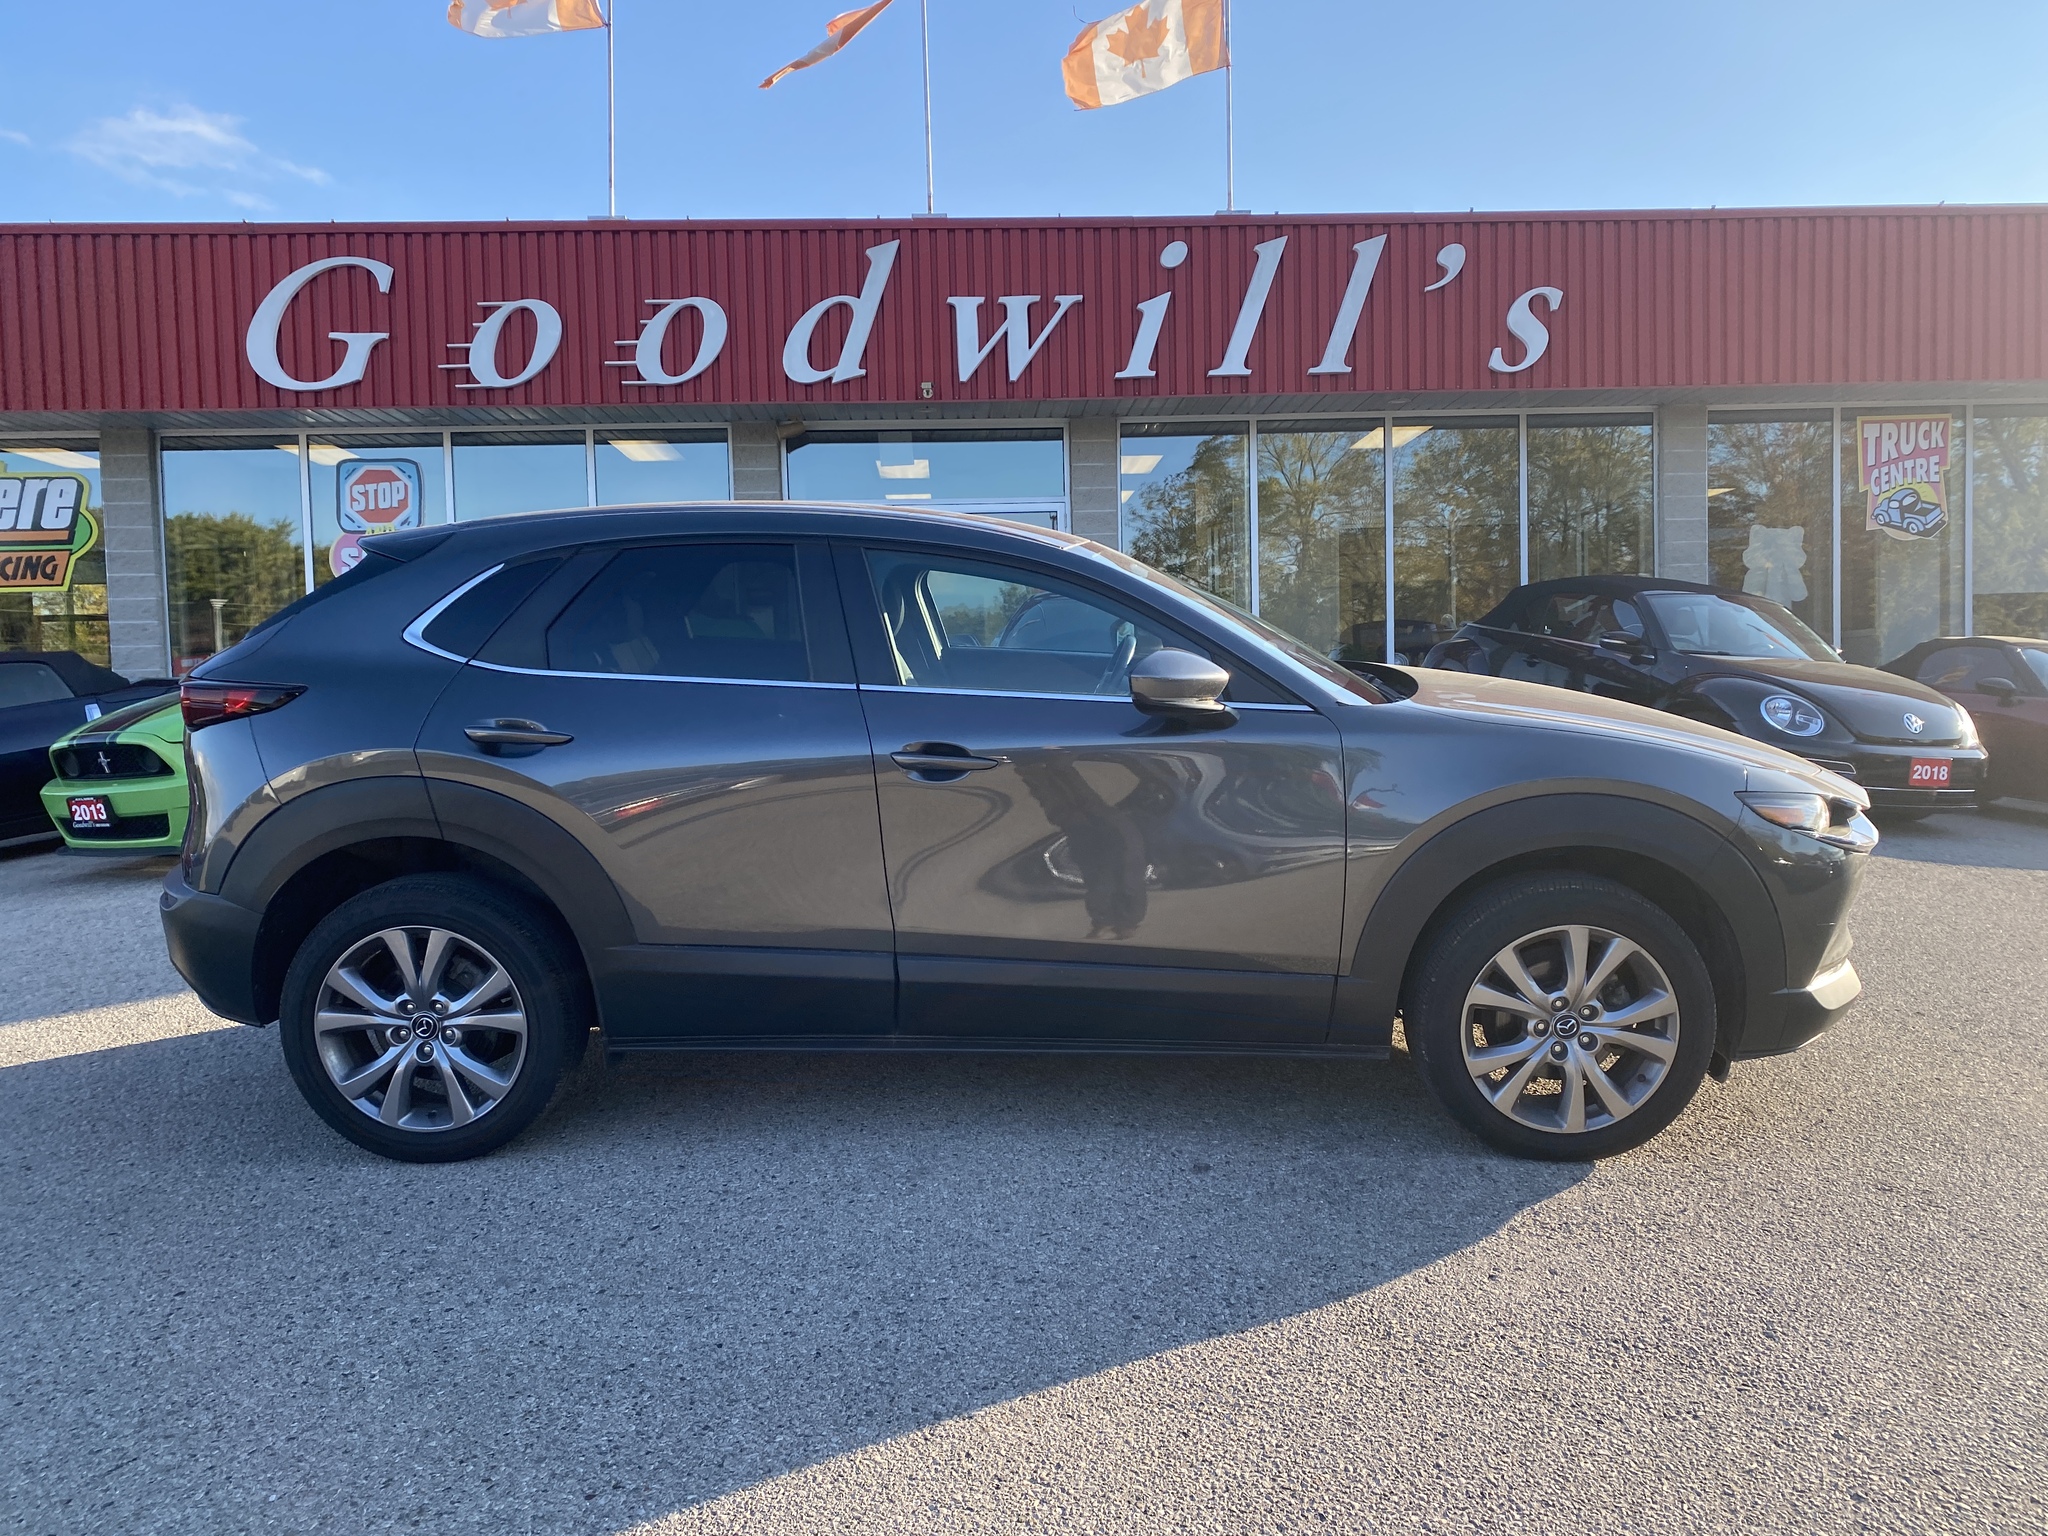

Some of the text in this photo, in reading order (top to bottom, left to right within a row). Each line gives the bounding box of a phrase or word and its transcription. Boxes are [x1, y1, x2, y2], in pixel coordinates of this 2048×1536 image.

[245, 234, 1564, 391] Goodwill's
[1863, 421, 1944, 467] TRUCK
[1870, 455, 1940, 496] CENTRE
[352, 480, 405, 511] STOP
[1912, 765, 1948, 780] 2018
[71, 803, 107, 821] 2013
